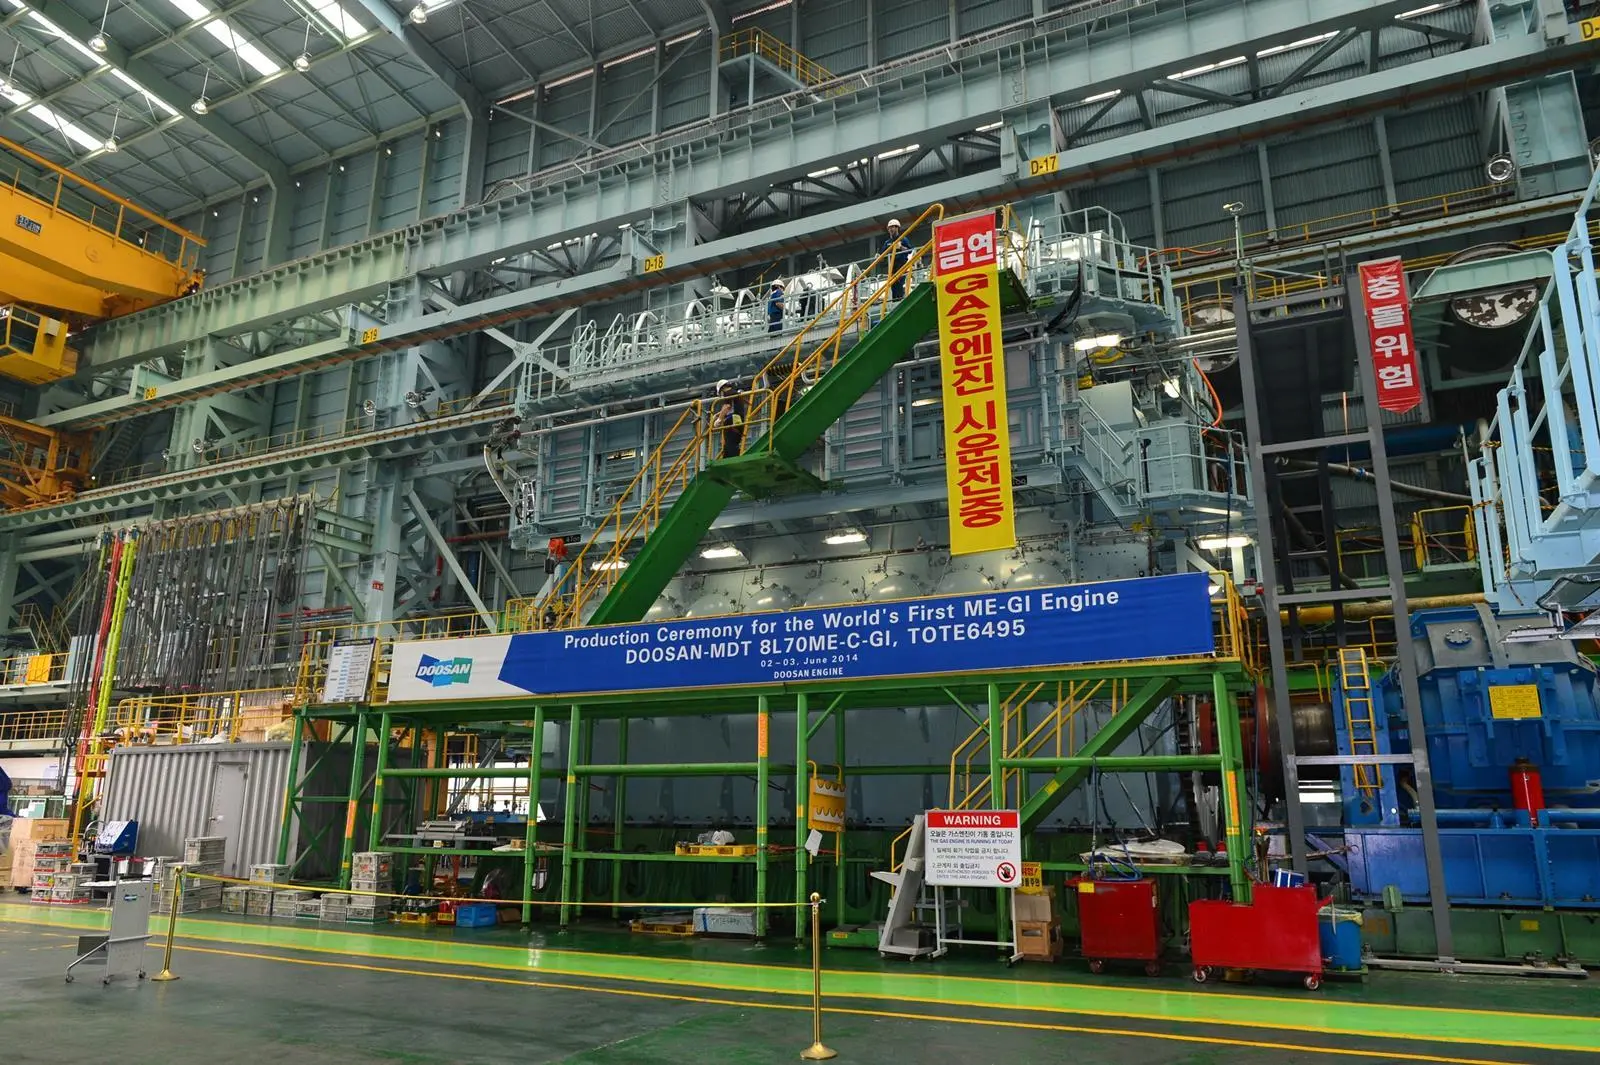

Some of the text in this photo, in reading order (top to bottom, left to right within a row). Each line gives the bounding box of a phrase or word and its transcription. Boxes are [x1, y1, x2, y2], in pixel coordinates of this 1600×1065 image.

[1031, 155, 1056, 175] D-17
[939, 230, 994, 270] 금연
[644, 256, 663, 271] D-18
[363, 329, 377, 342] D-19
[1367, 274, 1414, 390] 충돌위험
[945, 273, 1004, 528] GAS엔진 시운전중
[564, 590, 1119, 649] Production Ceremony for the World's First ME-GI Engine
[625, 619, 1025, 664] DOOSAN-MDT 8L70ME-C-GI, TOTE6495
[803, 656, 828, 666] June
[832, 653, 858, 663] 2014
[417, 663, 470, 677] DOOSAN
[774, 667, 843, 680] DOOSAN ENGINE
[944, 815, 1001, 825] WARNING
